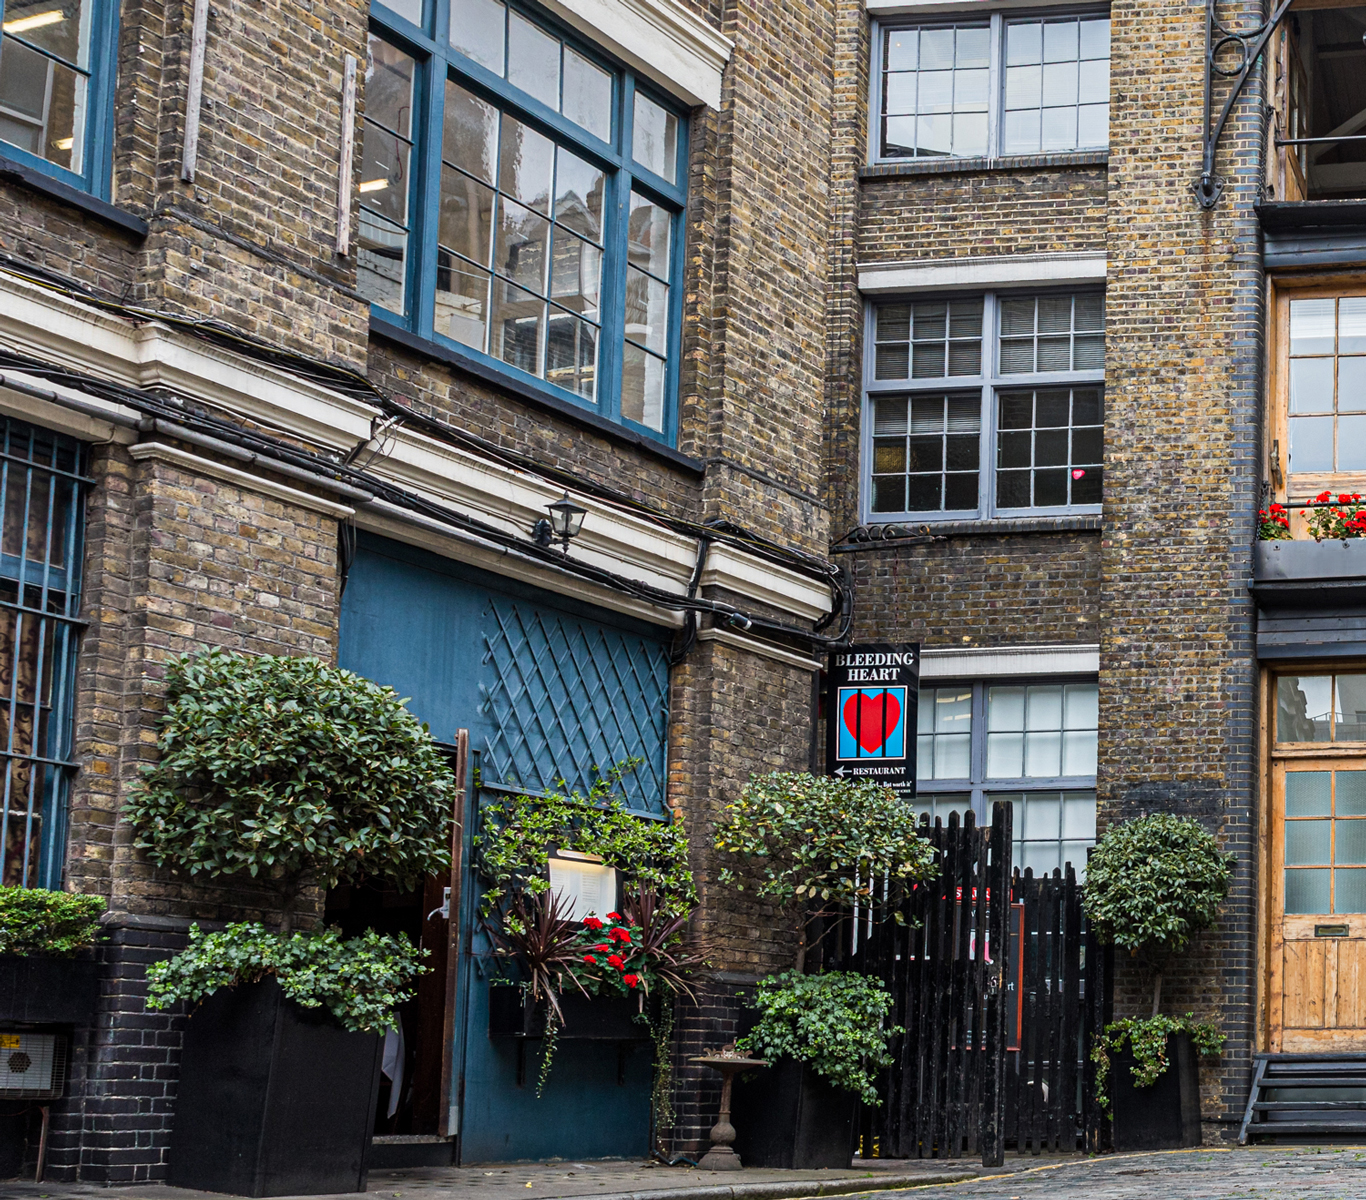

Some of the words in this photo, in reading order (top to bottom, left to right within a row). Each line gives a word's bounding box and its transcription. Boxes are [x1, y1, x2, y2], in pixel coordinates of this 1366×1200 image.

[835, 652, 914, 666] BLEEDING
[847, 668, 900, 681] HEART
[853, 767, 906, 775] RESTAURANT
